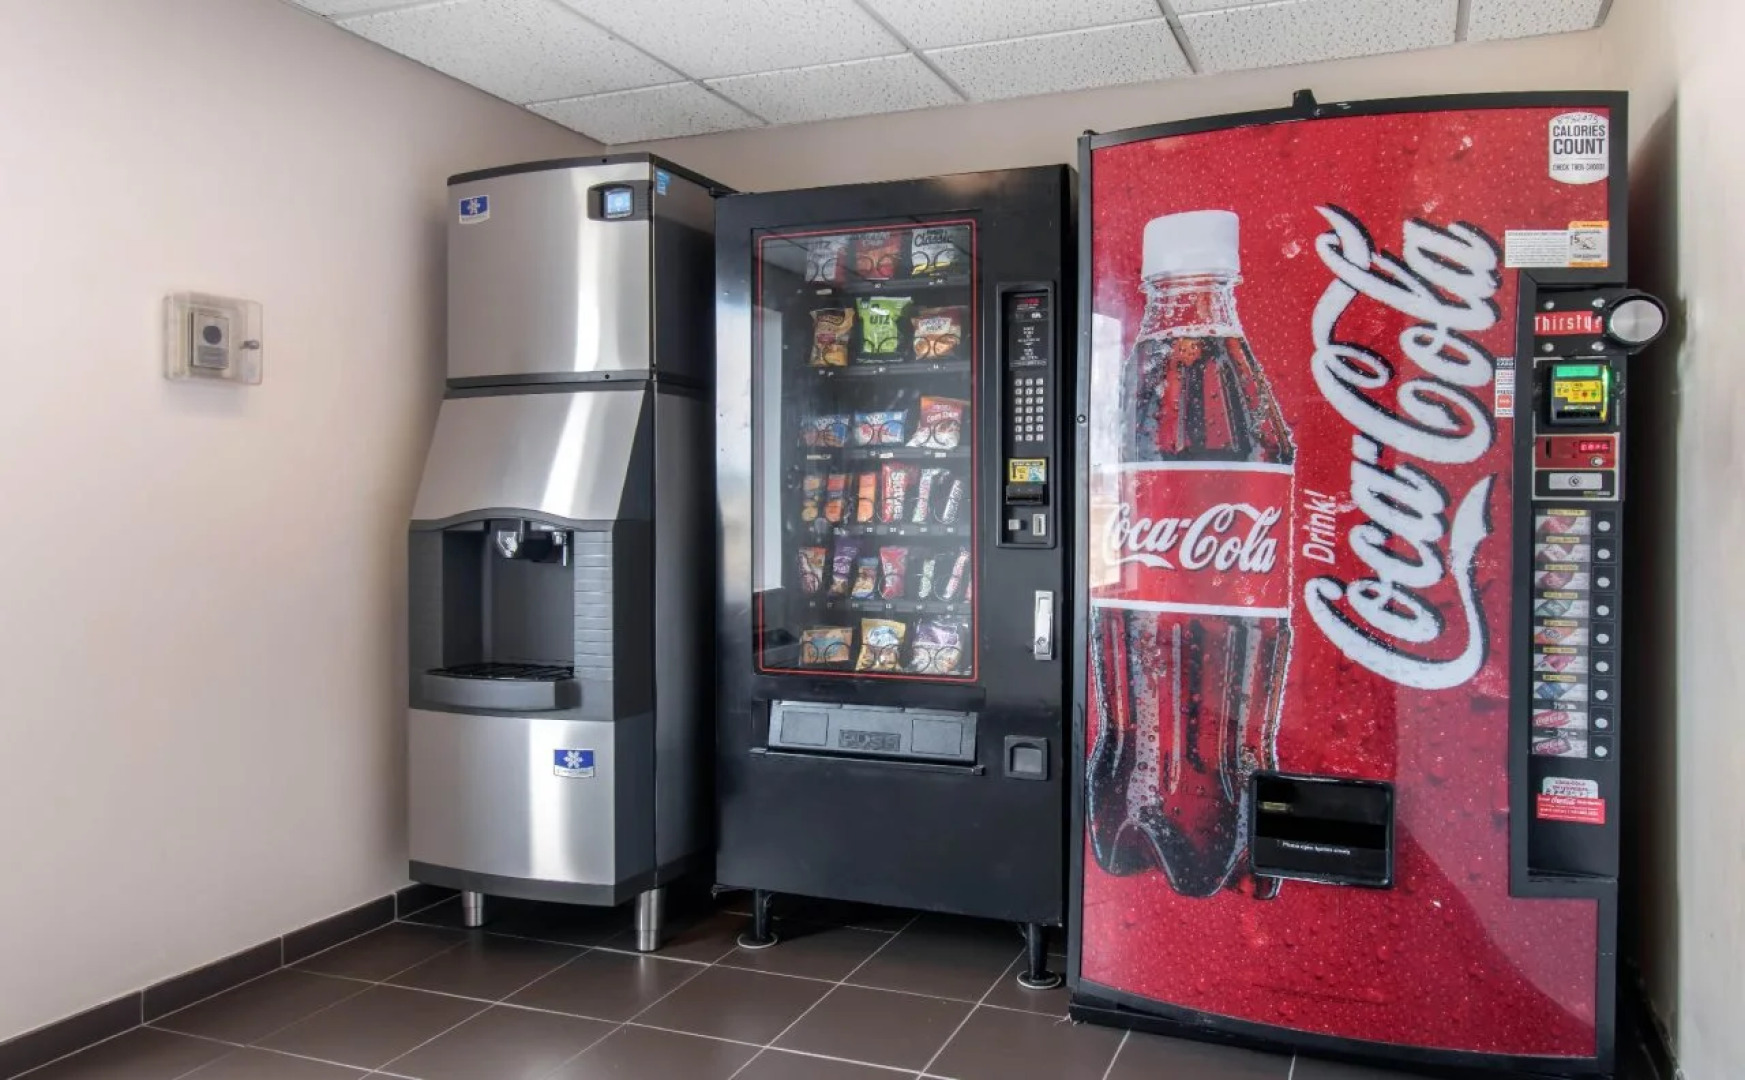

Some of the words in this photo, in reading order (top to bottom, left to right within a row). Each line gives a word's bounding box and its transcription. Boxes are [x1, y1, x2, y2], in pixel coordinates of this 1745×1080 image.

[1553, 124, 1606, 137] CALORIES
[1553, 138, 1605, 155] COUNT
[1305, 202, 1501, 690] Coca-Cola
[1102, 502, 1283, 574] Coca-Cola
[1302, 488, 1336, 566] Drink!
